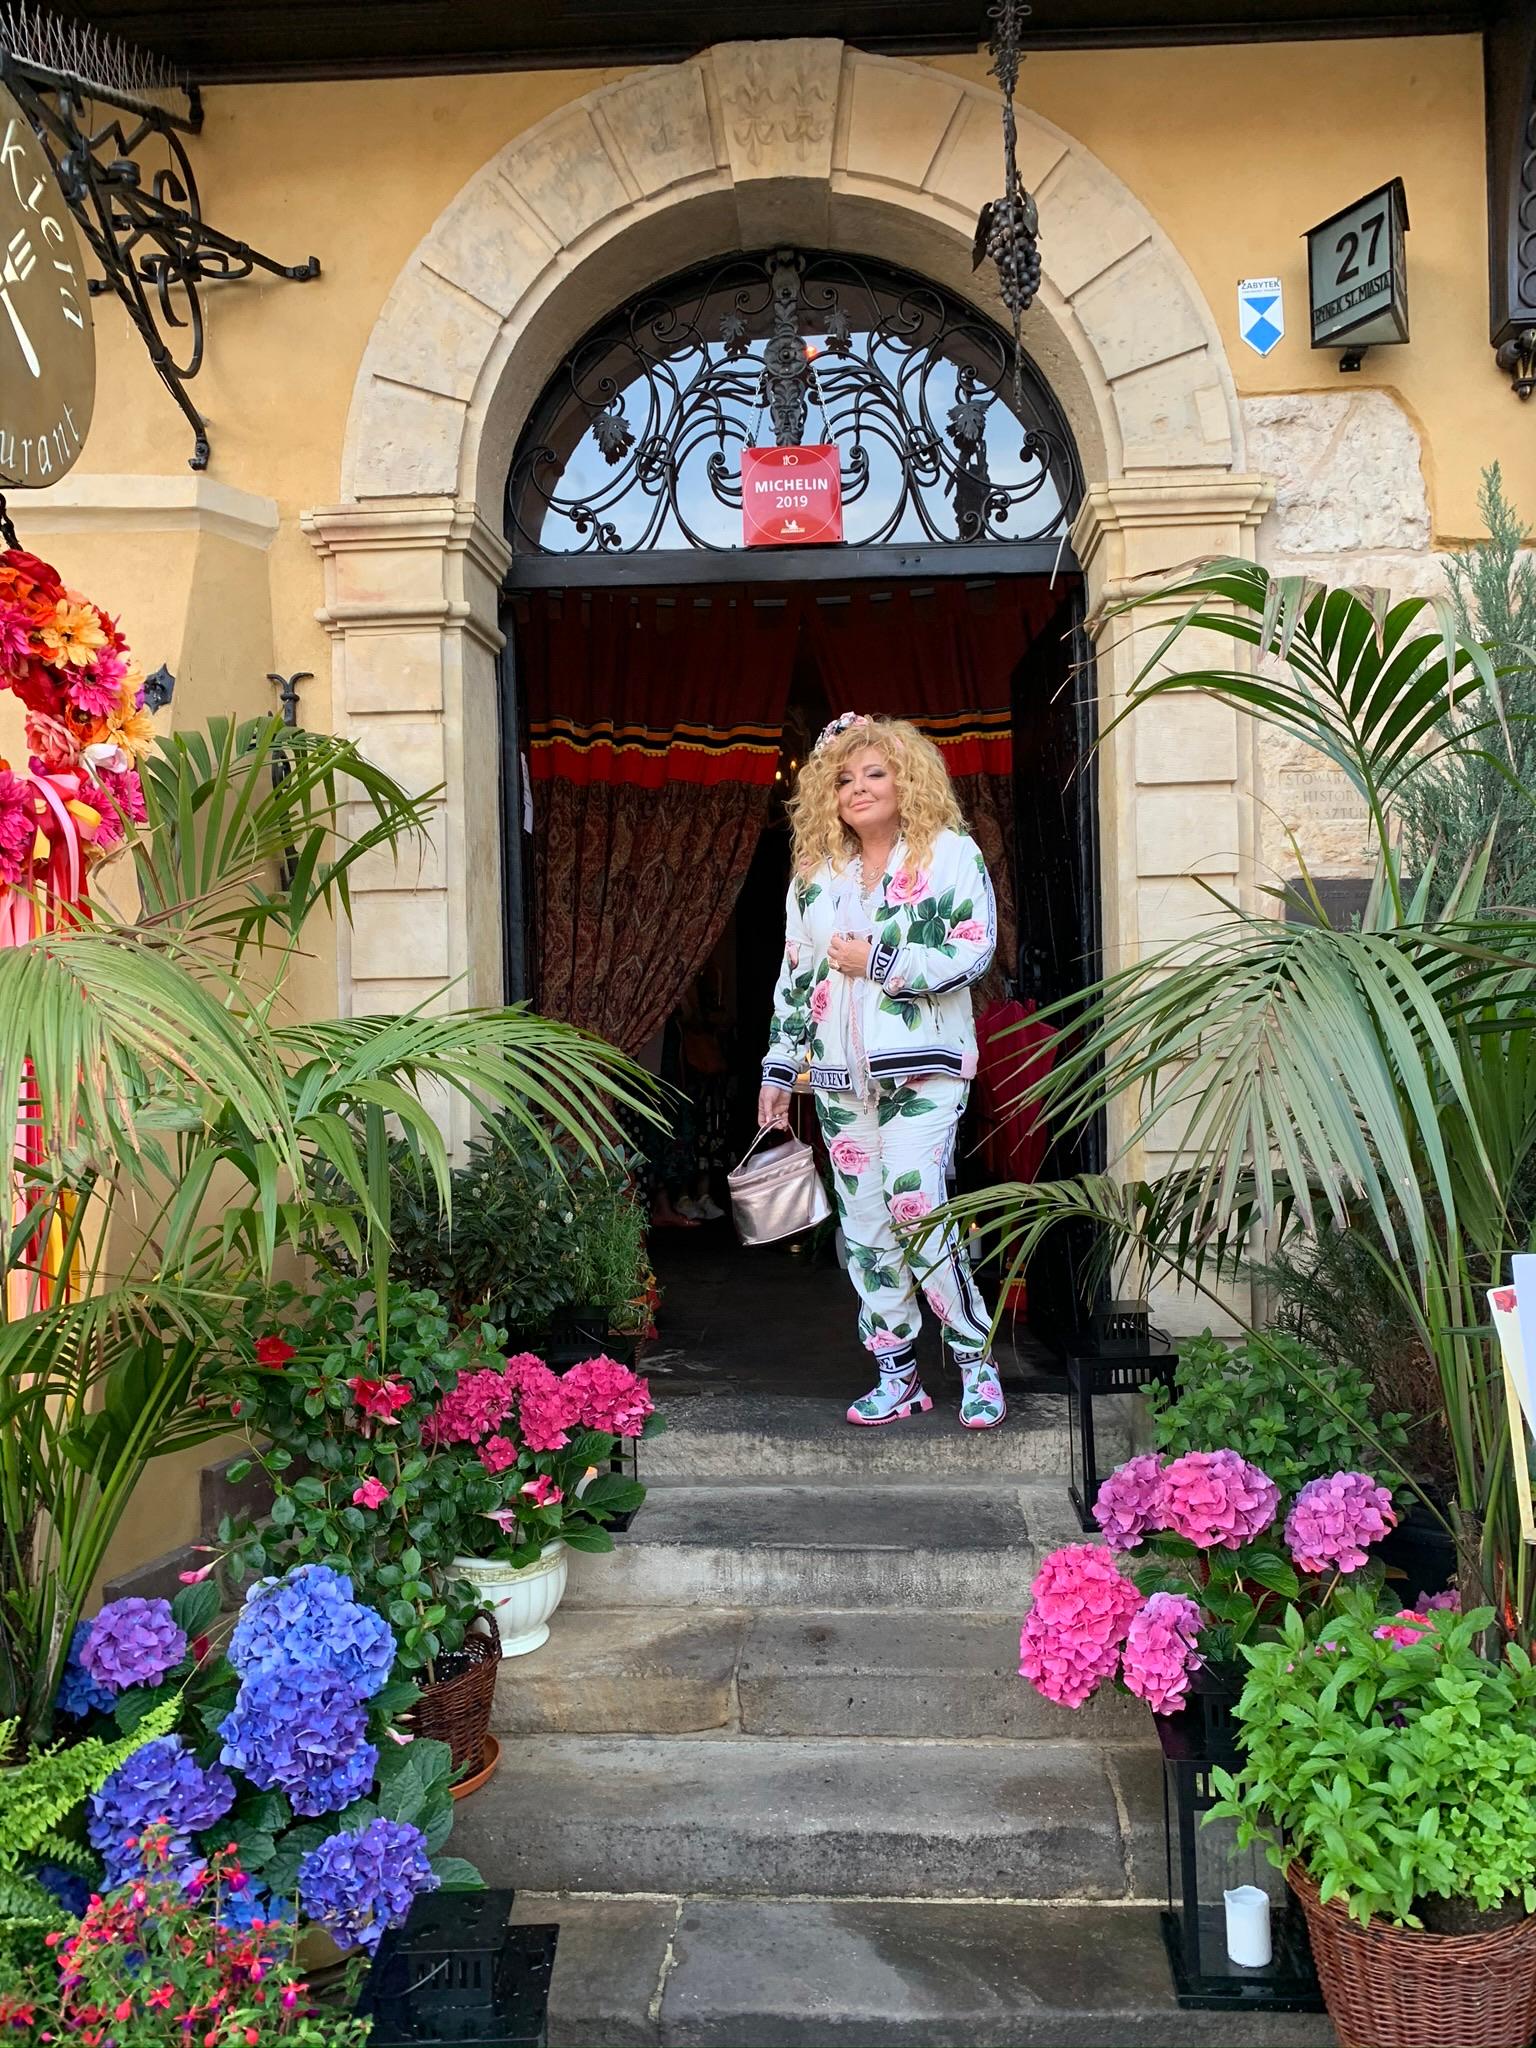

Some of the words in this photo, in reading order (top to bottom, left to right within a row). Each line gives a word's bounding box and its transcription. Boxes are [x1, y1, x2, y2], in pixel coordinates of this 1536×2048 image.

[1335, 211, 1385, 286] 27
[1241, 280, 1280, 289] ZABYTEK
[755, 478, 828, 493] MICHELIN
[775, 495, 808, 508] 2019
